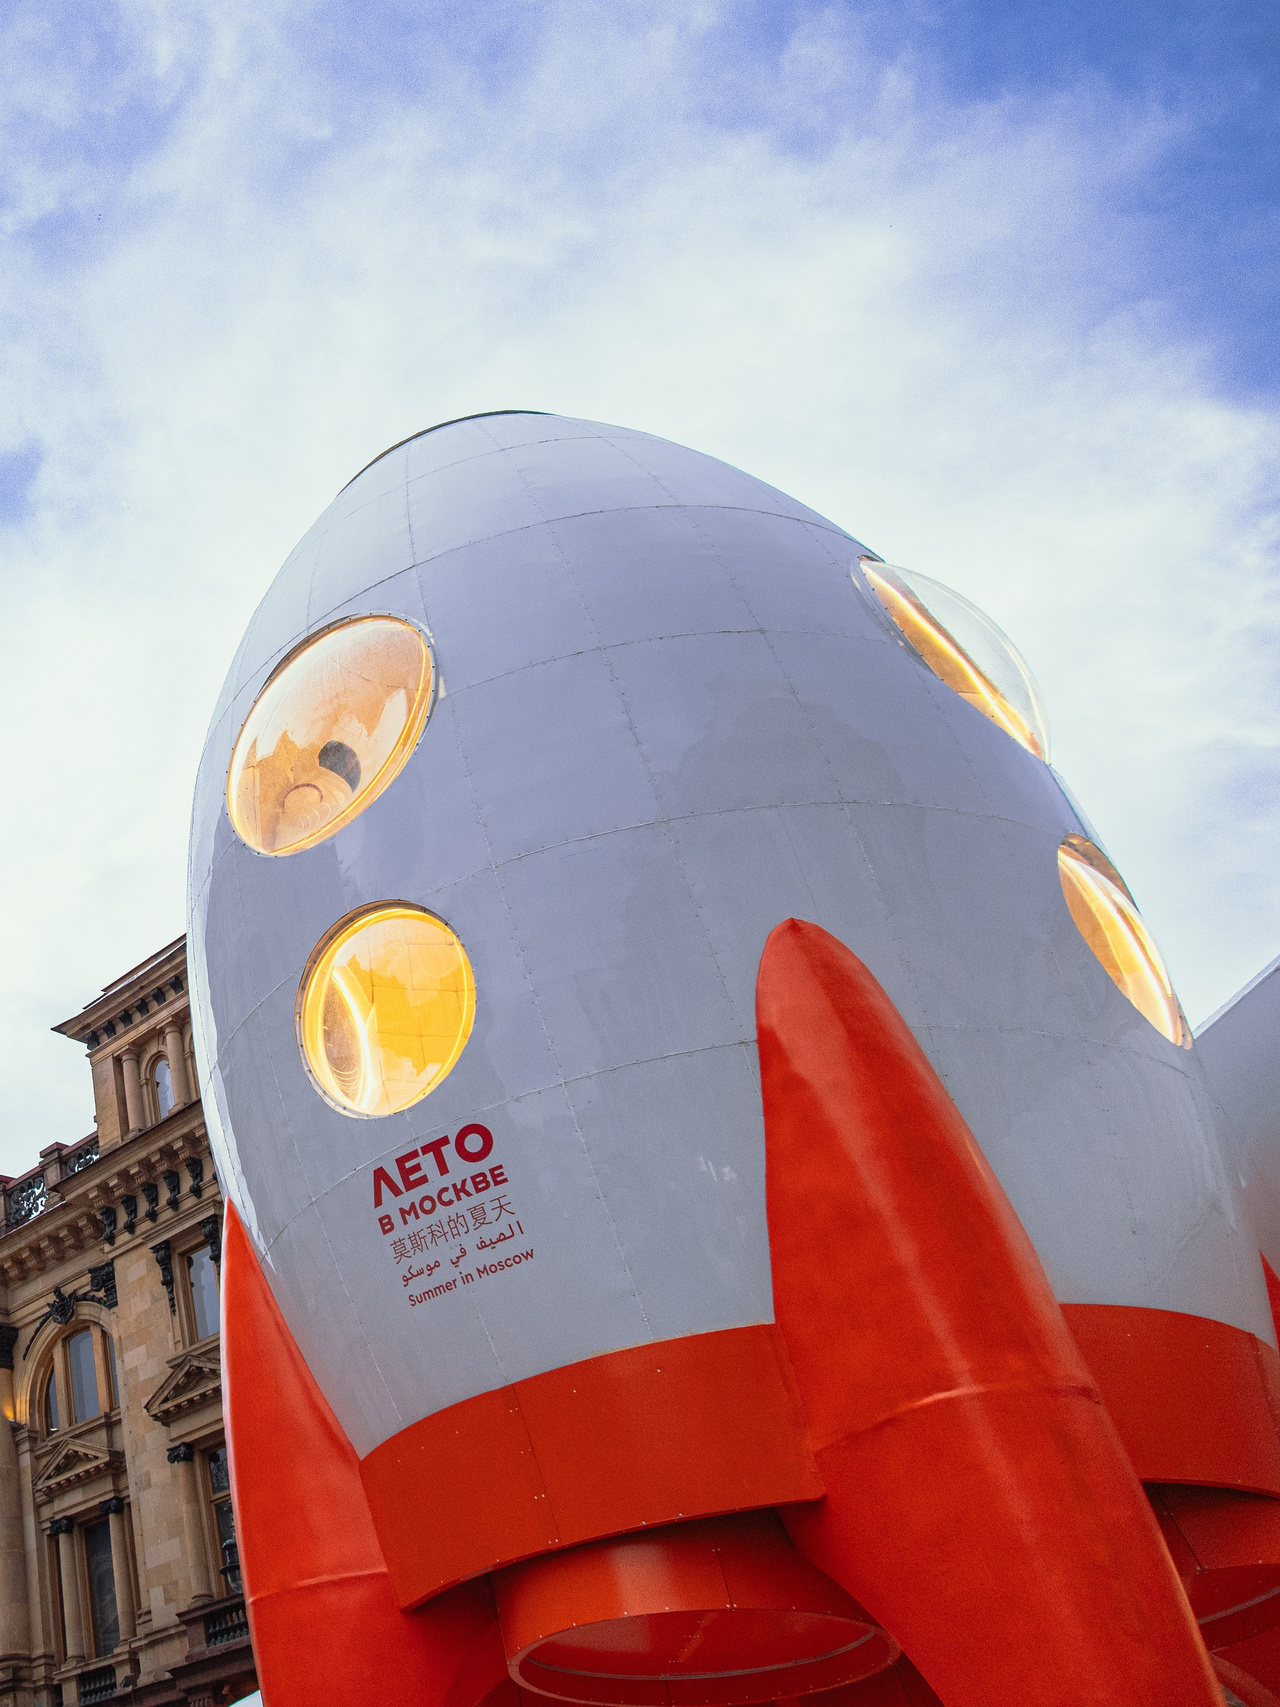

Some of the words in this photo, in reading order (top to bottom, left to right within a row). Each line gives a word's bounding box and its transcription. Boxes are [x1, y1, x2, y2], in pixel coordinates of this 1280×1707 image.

[373, 1123, 494, 1209] ЛЕТО
[378, 1214, 395, 1235] В
[398, 1164, 509, 1225] МОСКВЕ
[390, 1194, 515, 1265] 莫斯科的夏天
[450, 1243, 468, 1268] في
[476, 1220, 524, 1250] الصيف
[402, 1260, 441, 1287] موسكو
[408, 1278, 458, 1307] Summer
[460, 1271, 475, 1285] in
[475, 1248, 534, 1279] Moscow
